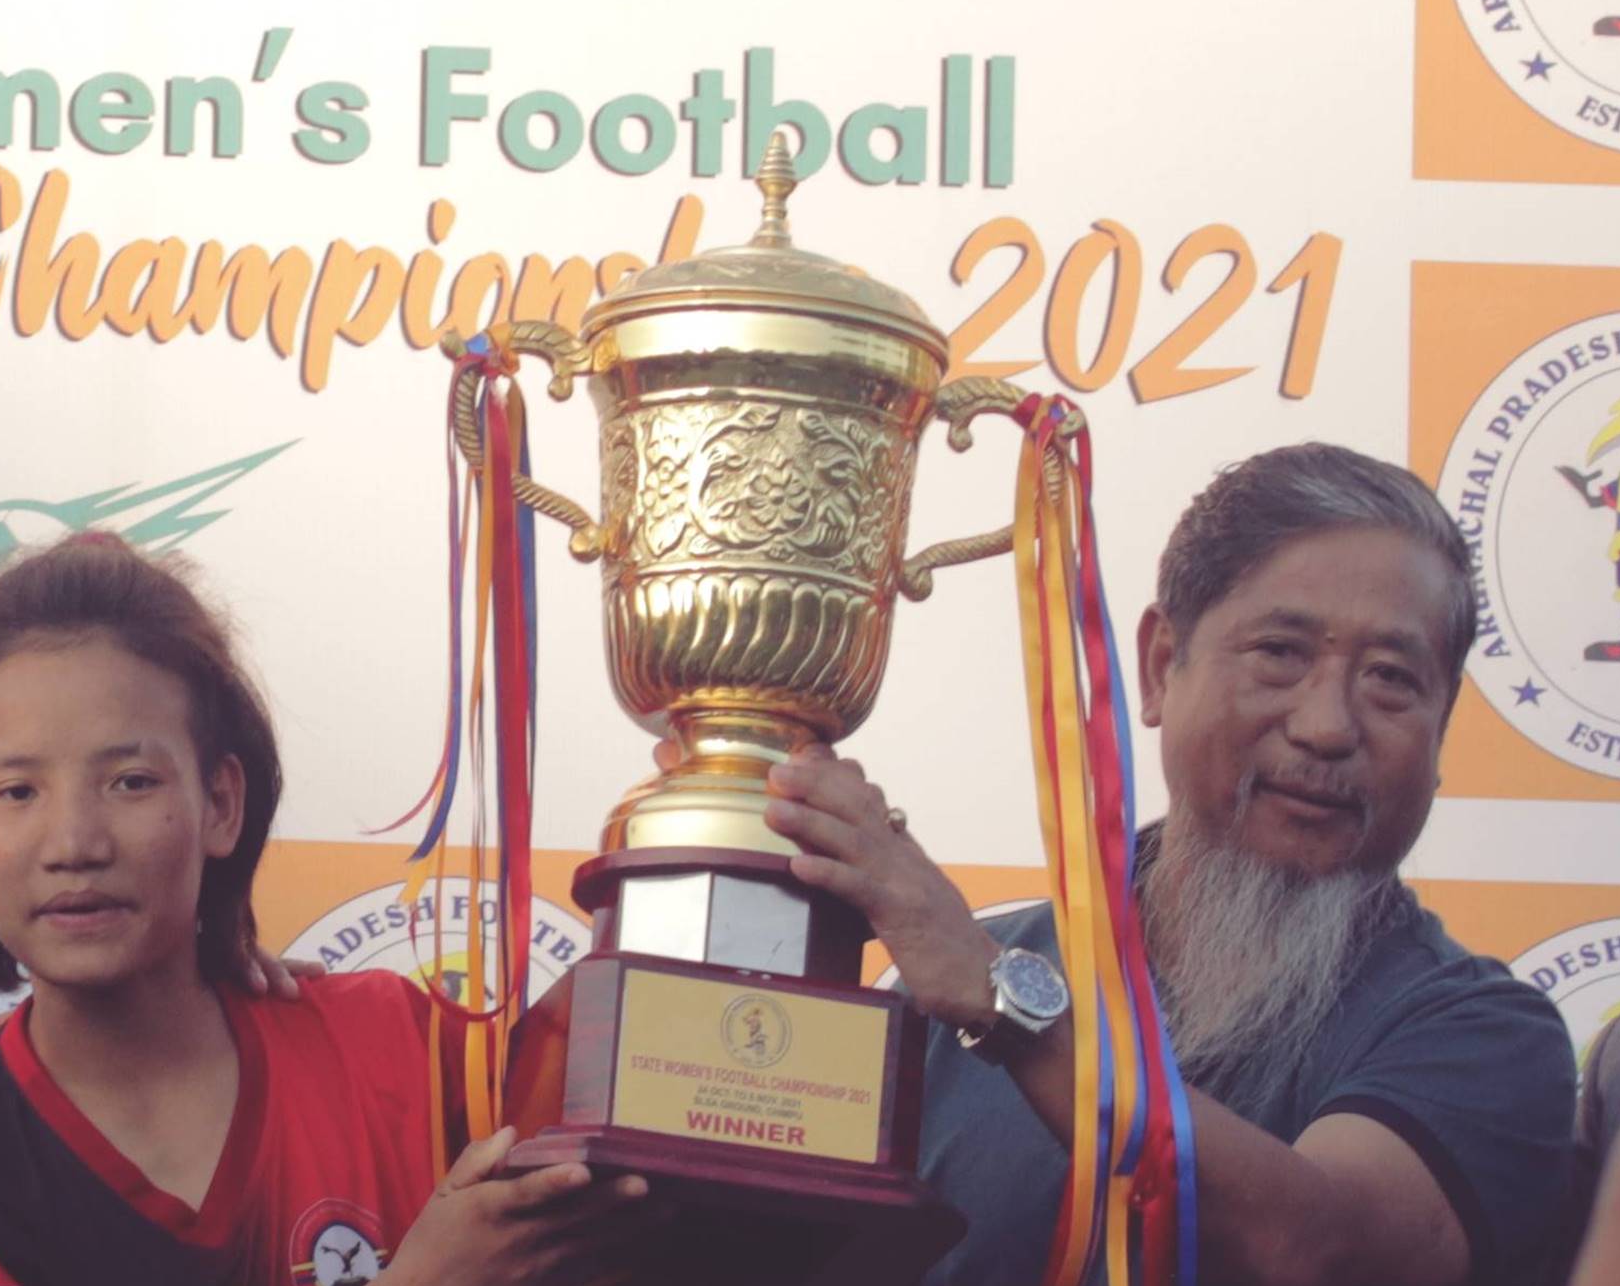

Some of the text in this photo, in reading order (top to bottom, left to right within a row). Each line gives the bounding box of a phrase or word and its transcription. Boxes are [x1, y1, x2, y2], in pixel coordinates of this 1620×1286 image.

[417, 43, 1018, 189] Football
[933, 214, 1345, 404] 2021
[686, 1110, 805, 1146] WINNER
